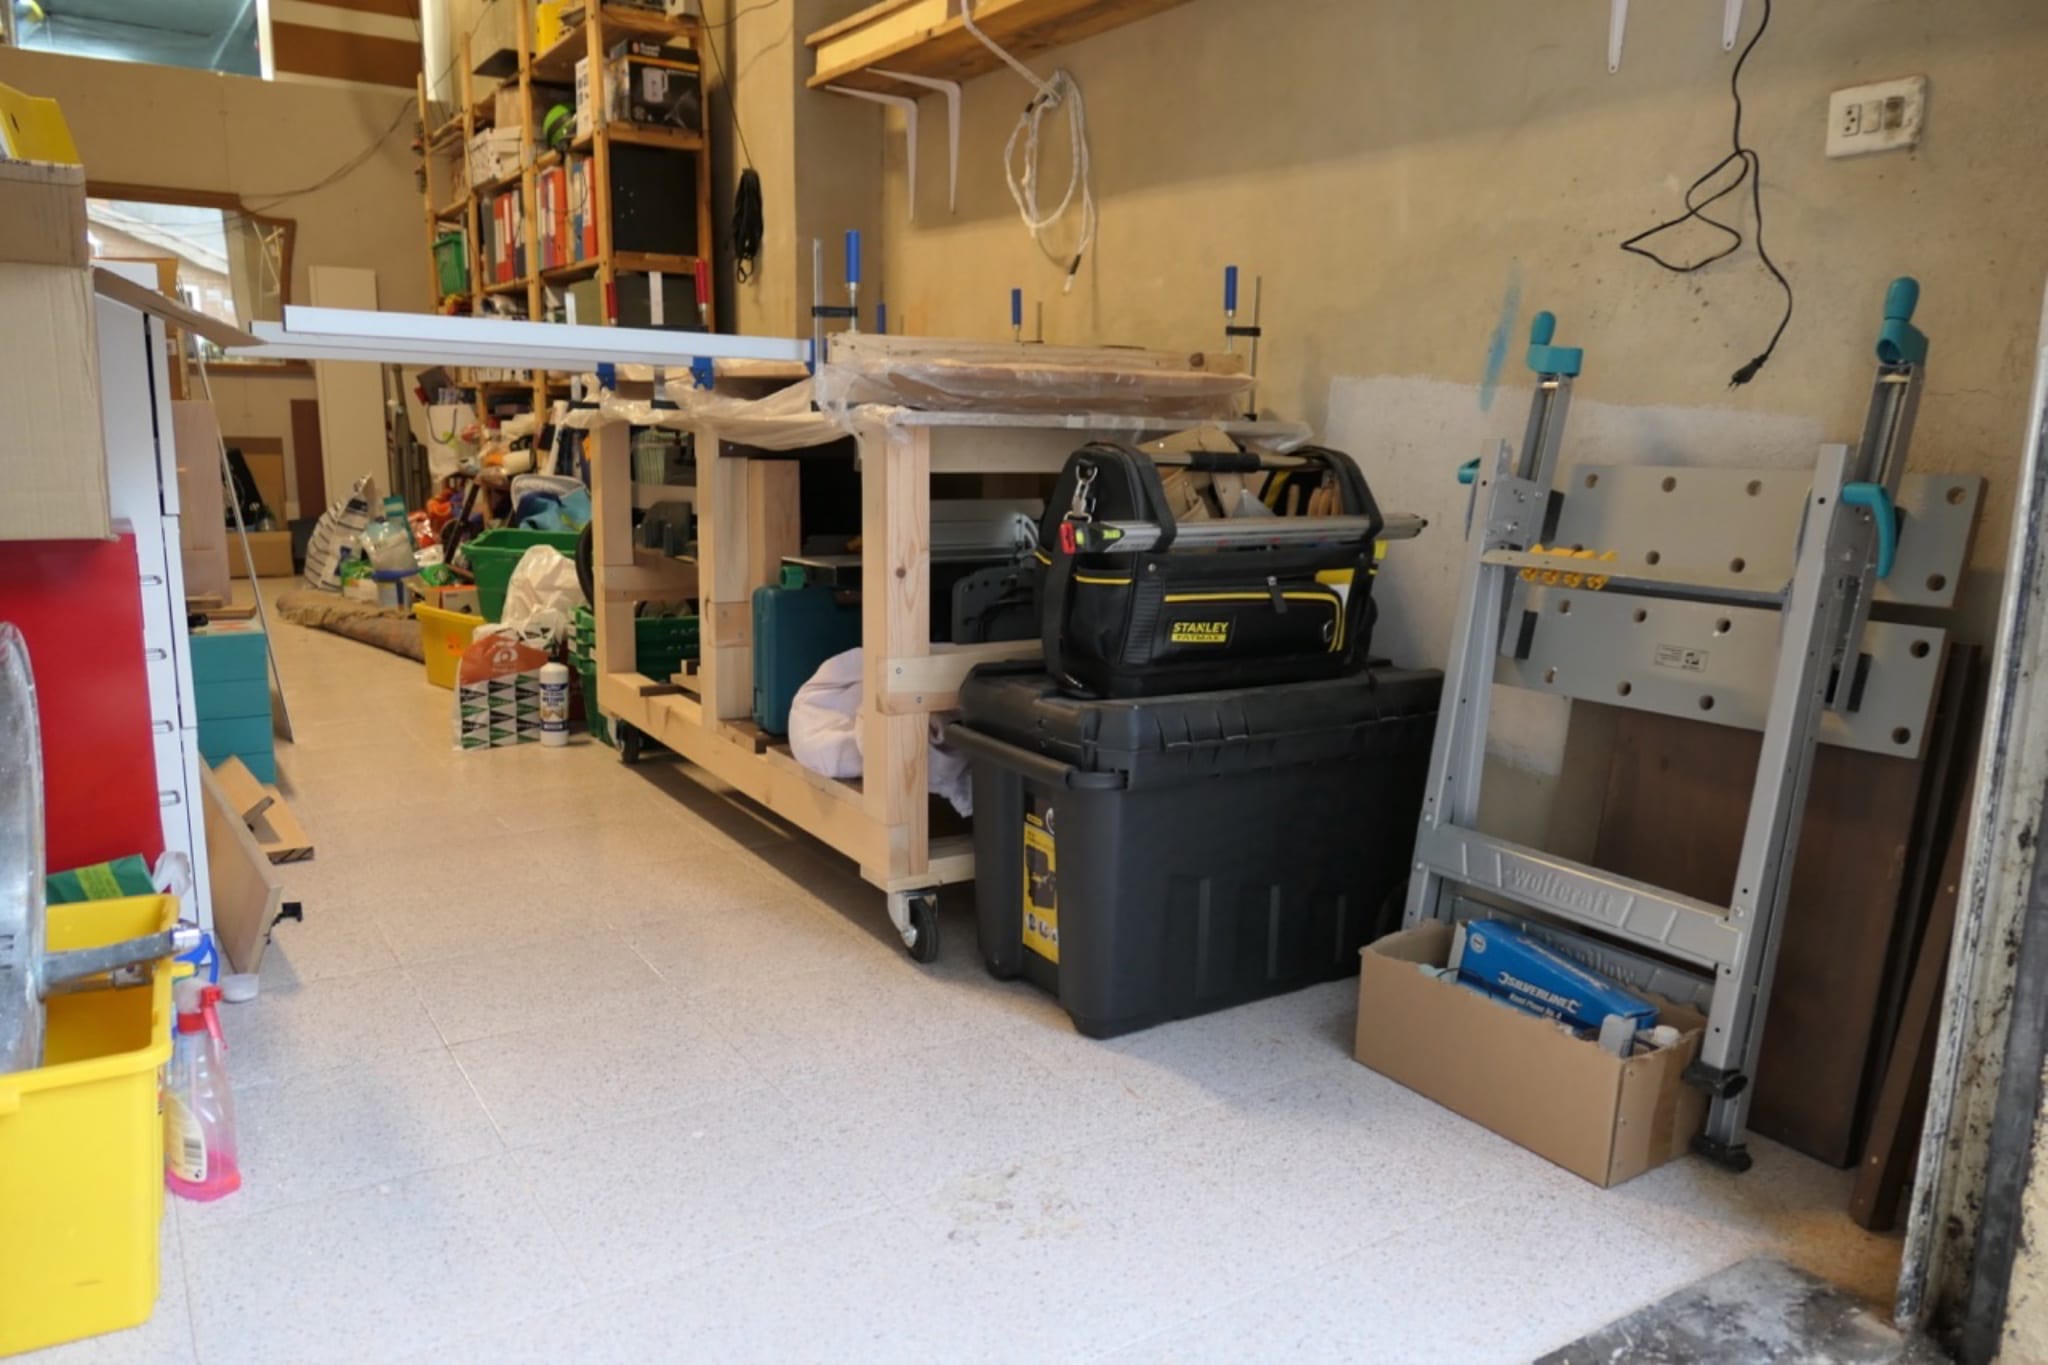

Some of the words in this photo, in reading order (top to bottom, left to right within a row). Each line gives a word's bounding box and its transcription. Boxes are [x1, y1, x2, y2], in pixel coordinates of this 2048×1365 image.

[1173, 621, 1229, 633] STANLEY
[1513, 866, 1612, 914] wolfcraft
[1502, 973, 1574, 1011] SILVERLINE
